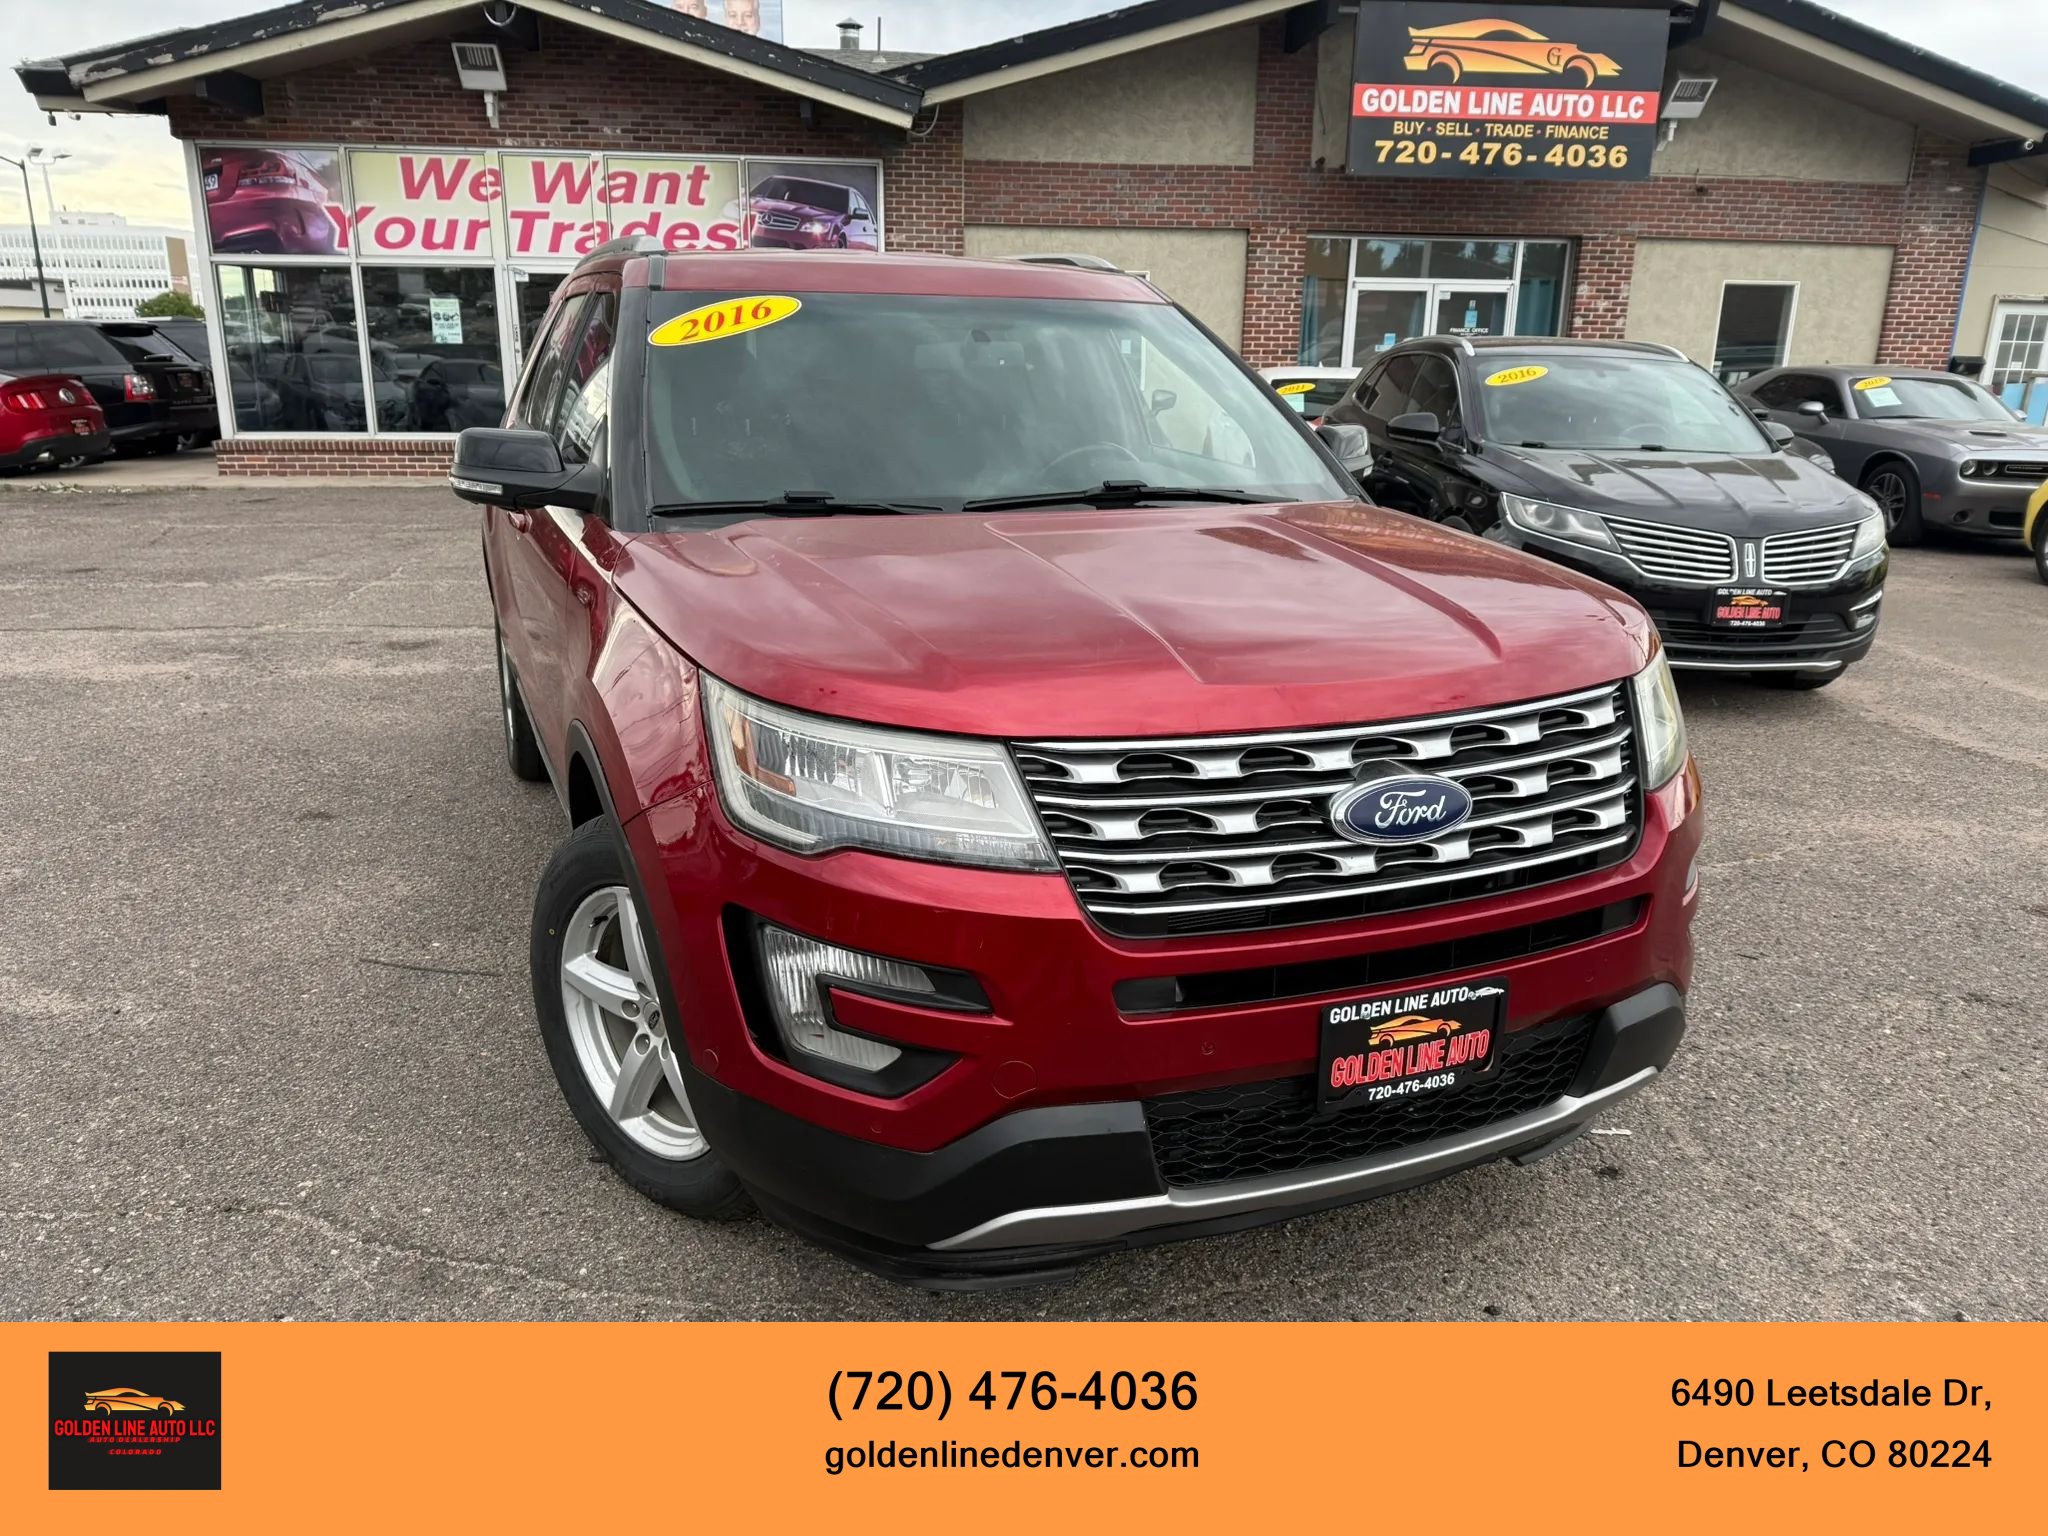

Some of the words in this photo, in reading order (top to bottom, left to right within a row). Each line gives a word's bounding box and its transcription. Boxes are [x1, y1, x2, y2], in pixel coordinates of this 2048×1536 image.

[1361, 88, 1461, 114] GOLDEN
[1467, 91, 1523, 116] LINE
[1528, 93, 1595, 118] AUTO
[1600, 95, 1645, 119] LLC
[1393, 121, 1426, 135] BUY
[1435, 123, 1473, 137] SELL
[1484, 124, 1534, 138] TRADE
[1545, 125, 1609, 140] FINANCE
[400, 156, 502, 201] We
[531, 160, 710, 206] Want
[324, 205, 491, 251] Your
[680, 298, 772, 341] 2016
[1498, 367, 1537, 384] 2016
[1742, 588, 1755, 596] LINE
[1756, 588, 1773, 596] AUTO
[1717, 606, 1744, 619] GOLDEN
[1745, 606, 1762, 619] LINE
[1762, 606, 1781, 620] AUTO
[1374, 789, 1447, 829] Ford
[1330, 1002, 1391, 1024] GOLDEN
[1394, 993, 1429, 1014] LINE
[1430, 986, 1469, 1008] AUTO
[1330, 1046, 1404, 1088] GOLDEN
[1405, 1038, 1446, 1076] LINE
[1446, 1028, 1490, 1067] AUTO
[1368, 1072, 1455, 1101] 720-476-4036
